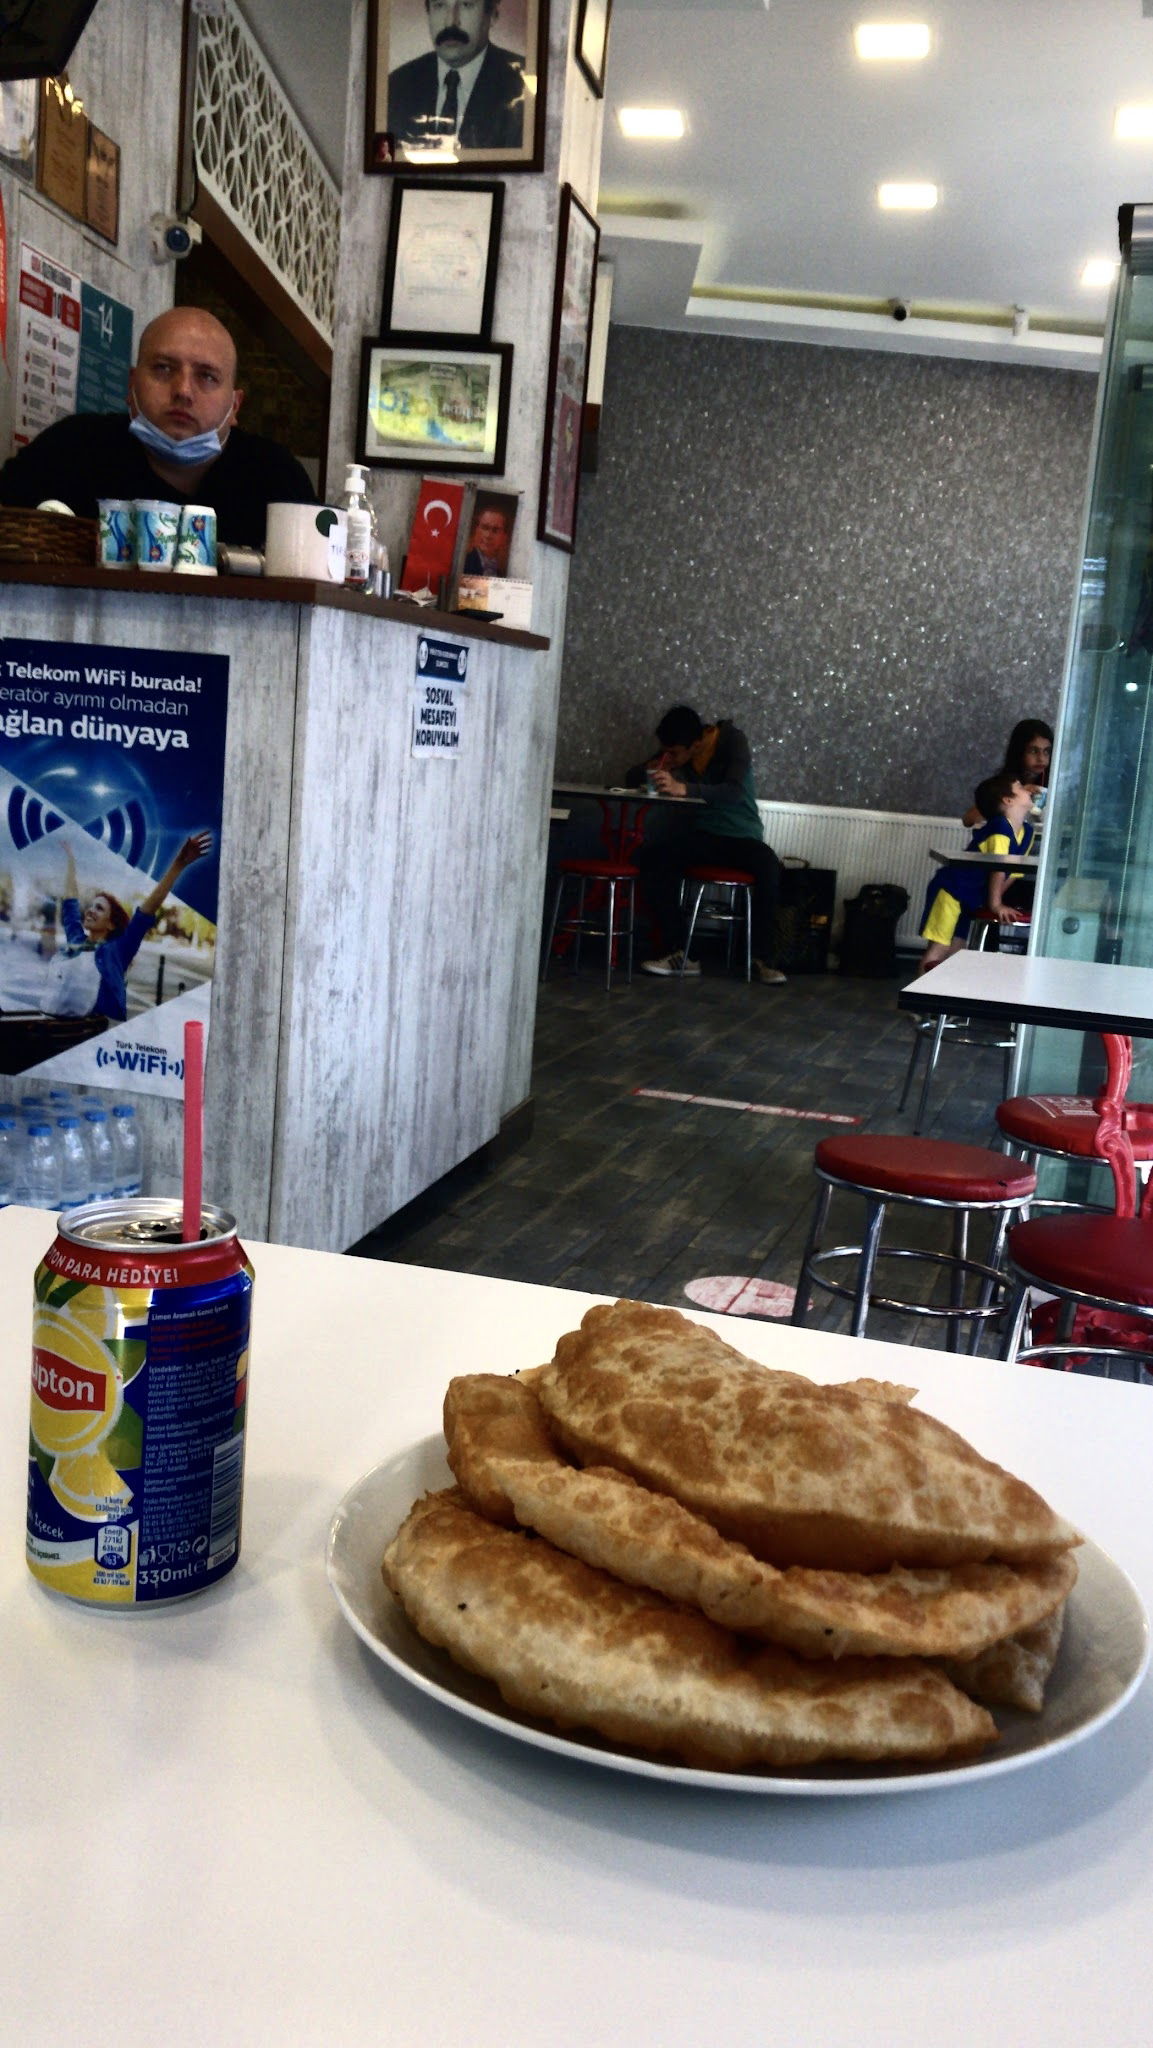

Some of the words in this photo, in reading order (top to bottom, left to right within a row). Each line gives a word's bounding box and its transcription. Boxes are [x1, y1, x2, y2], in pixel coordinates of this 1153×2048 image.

[6, 661, 80, 683] Telekom
[84, 667, 126, 687] WiFi
[131, 671, 202, 693] burada!
[53, 691, 105, 710] ayrımı
[110, 694, 189, 716] olmadan
[426, 687, 454, 706] SOSYAL
[420, 708, 457, 727] MESAFEYİ
[70, 714, 189, 751] dünyaya
[415, 729, 459, 748] KORUYALIM
[116, 1040, 133, 1050] Türk
[135, 1042, 167, 1055] Telekom
[115, 1050, 167, 1076] WiFi
[64, 1258, 102, 1280] PARA
[106, 1264, 179, 1284] HEDİYE!
[151, 1313, 172, 1321] Limon
[138, 1562, 193, 1585] 330ml
